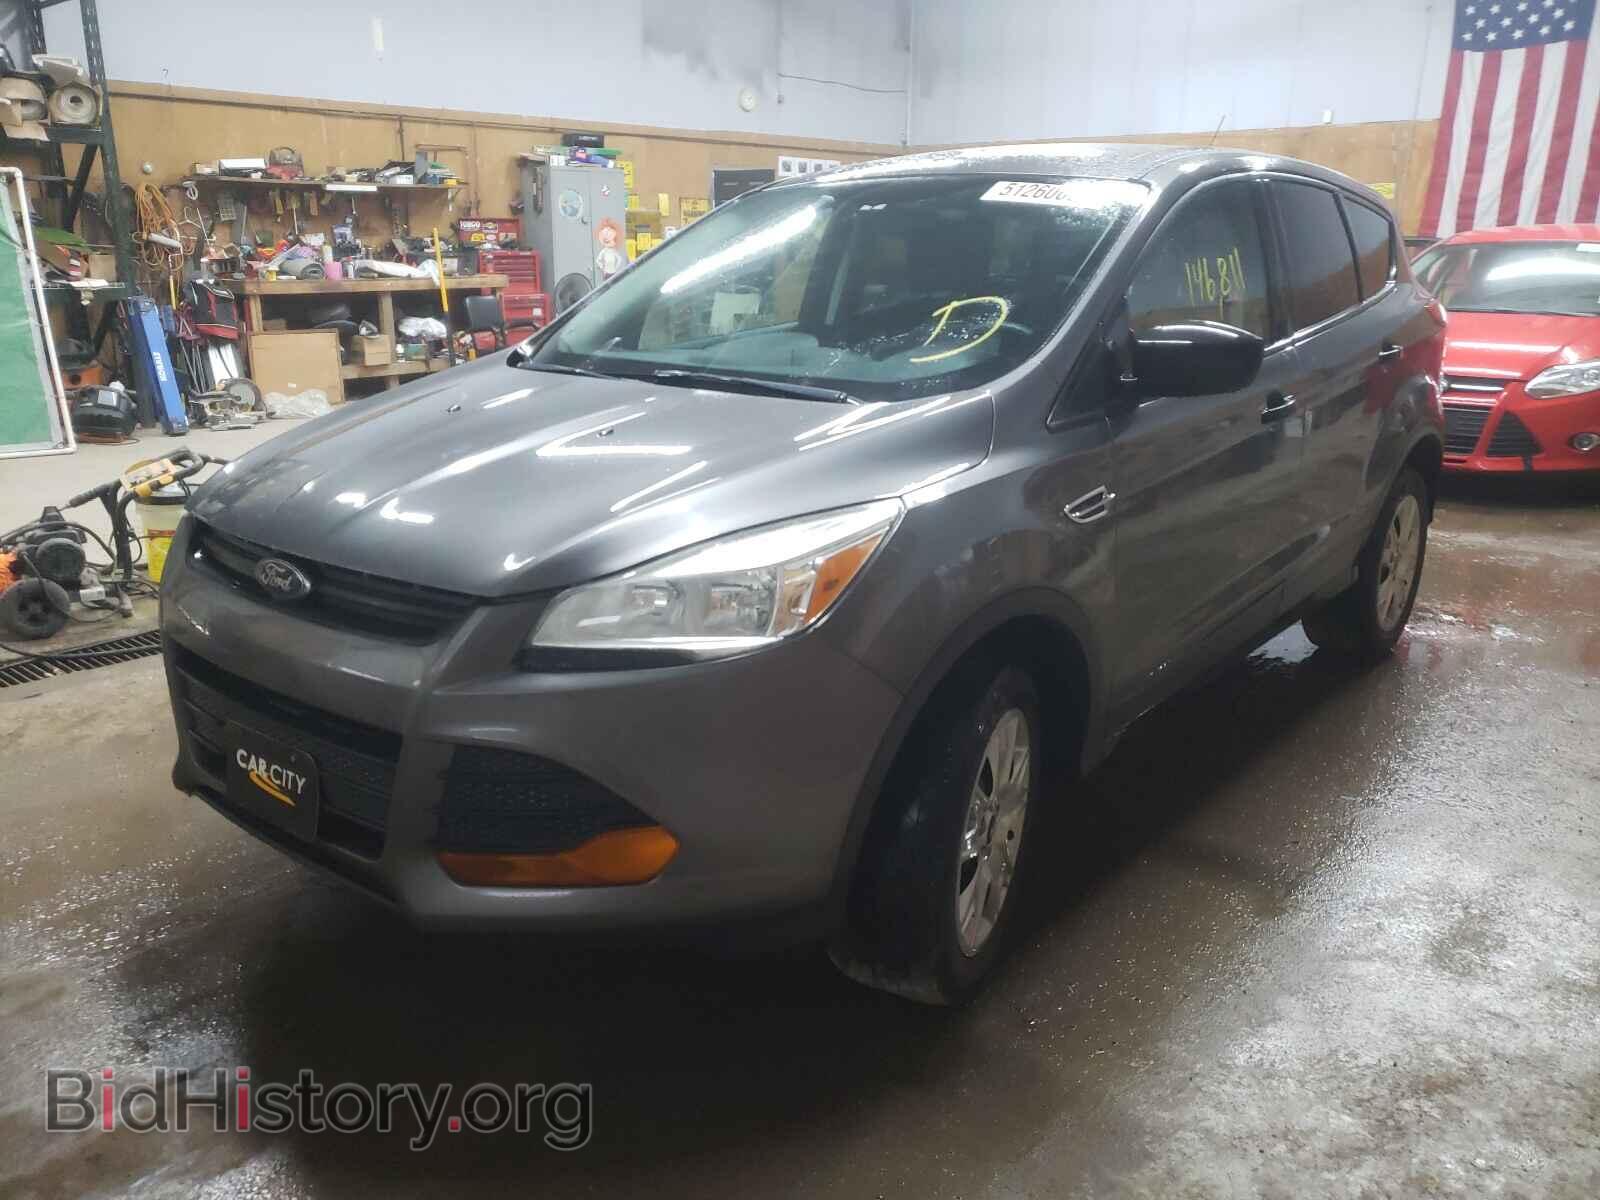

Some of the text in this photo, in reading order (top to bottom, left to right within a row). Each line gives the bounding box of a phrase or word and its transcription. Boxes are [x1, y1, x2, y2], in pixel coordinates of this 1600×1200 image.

[999, 182, 1072, 201] 512600
[909, 296, 1009, 362] D
[262, 562, 293, 592] Ford
[236, 748, 307, 795] CAR CITY
